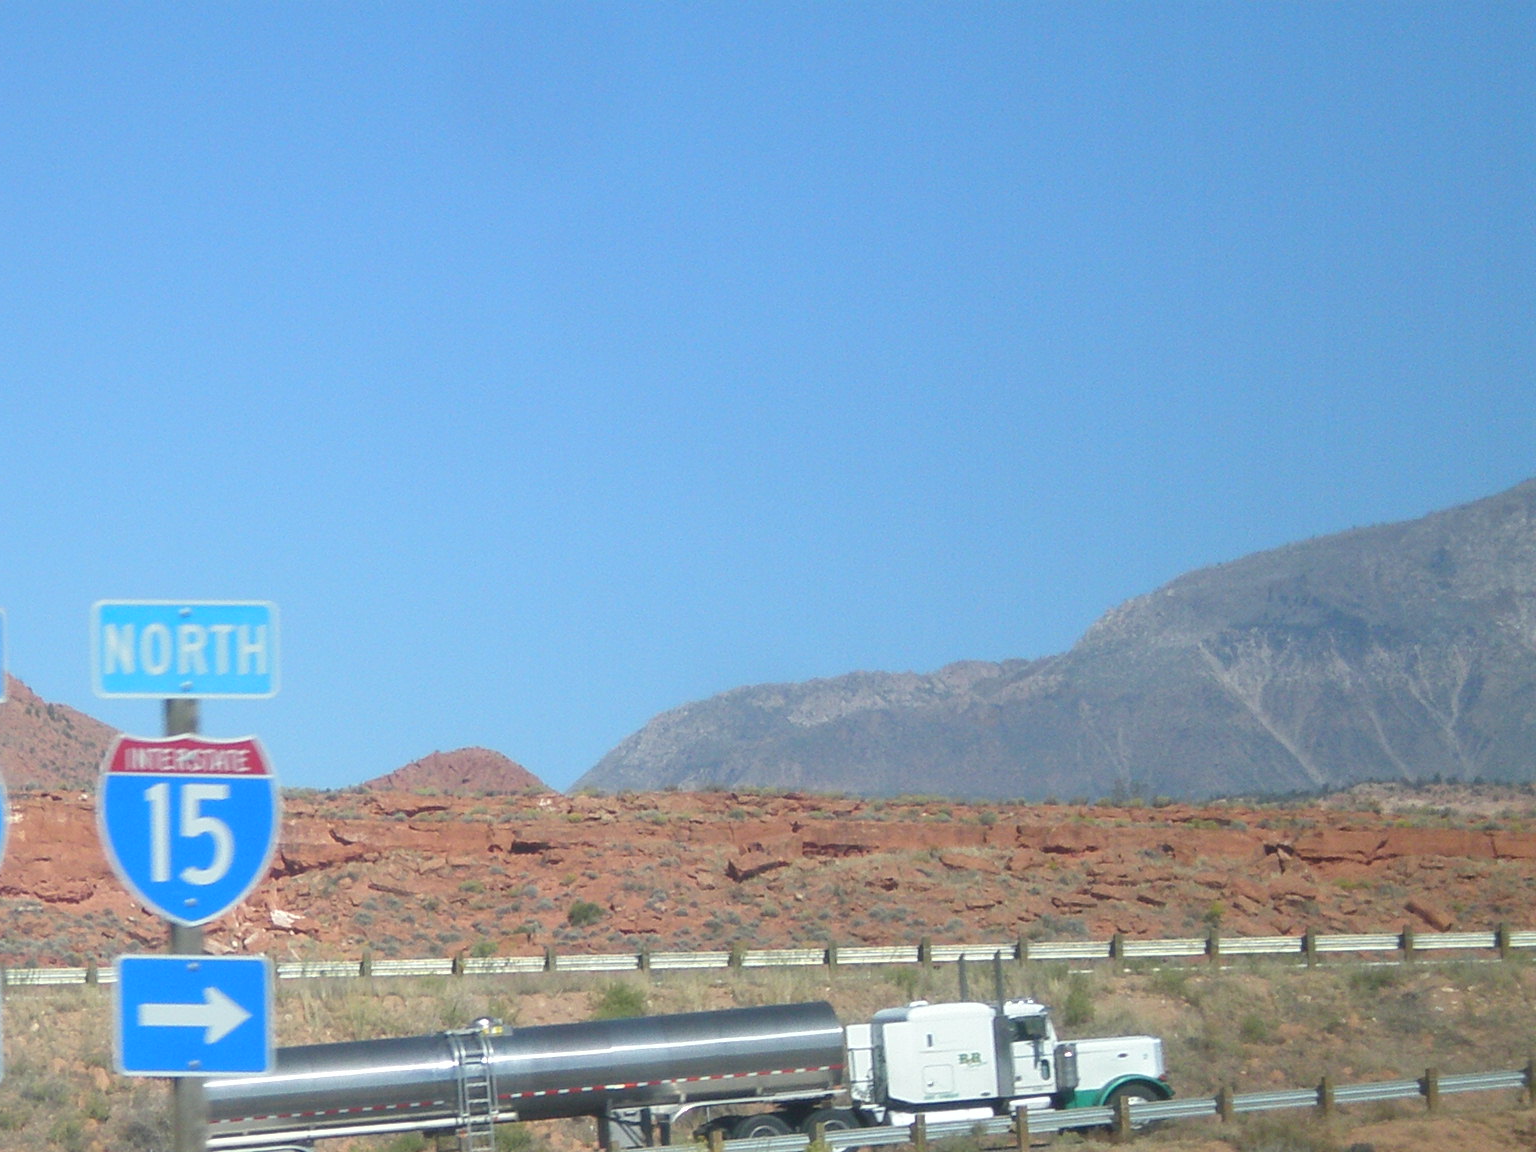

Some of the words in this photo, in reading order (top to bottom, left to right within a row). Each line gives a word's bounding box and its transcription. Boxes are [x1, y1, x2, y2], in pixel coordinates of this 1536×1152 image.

[104, 622, 267, 676] NORTH
[124, 747, 251, 773] INTERSTATE
[144, 782, 234, 886] 15
